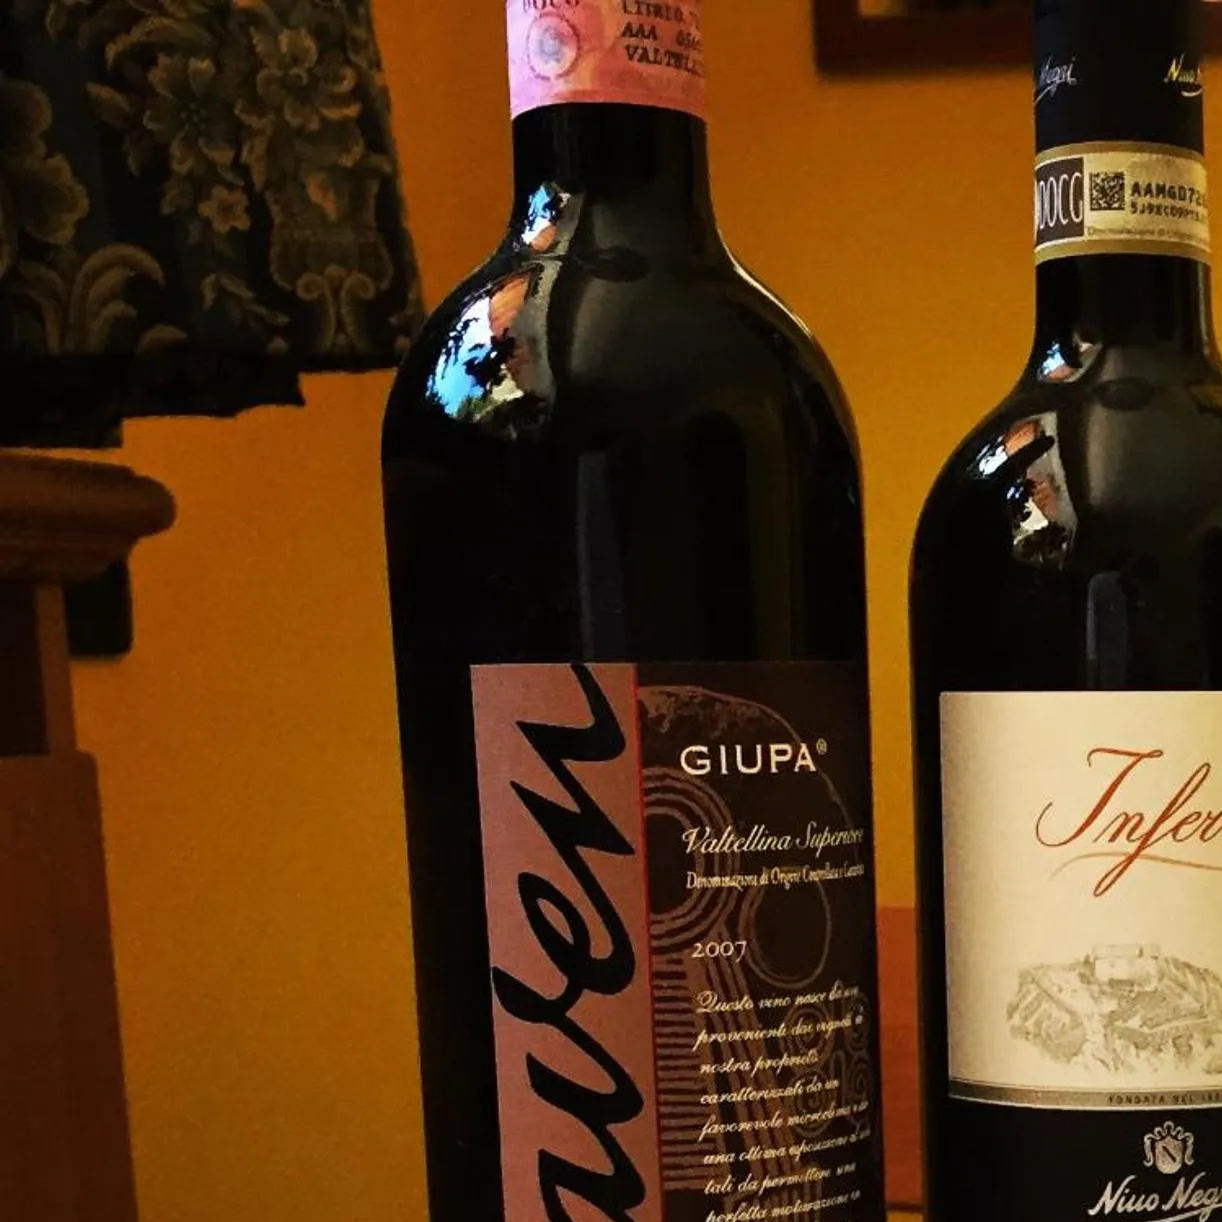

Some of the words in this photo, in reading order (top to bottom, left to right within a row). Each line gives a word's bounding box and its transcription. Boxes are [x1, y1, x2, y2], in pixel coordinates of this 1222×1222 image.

[682, 823, 793, 855] Valtellina
[691, 941, 747, 963] 2007
[695, 990, 754, 1014] Questo
[1087, 1174, 1160, 1216] Nino
